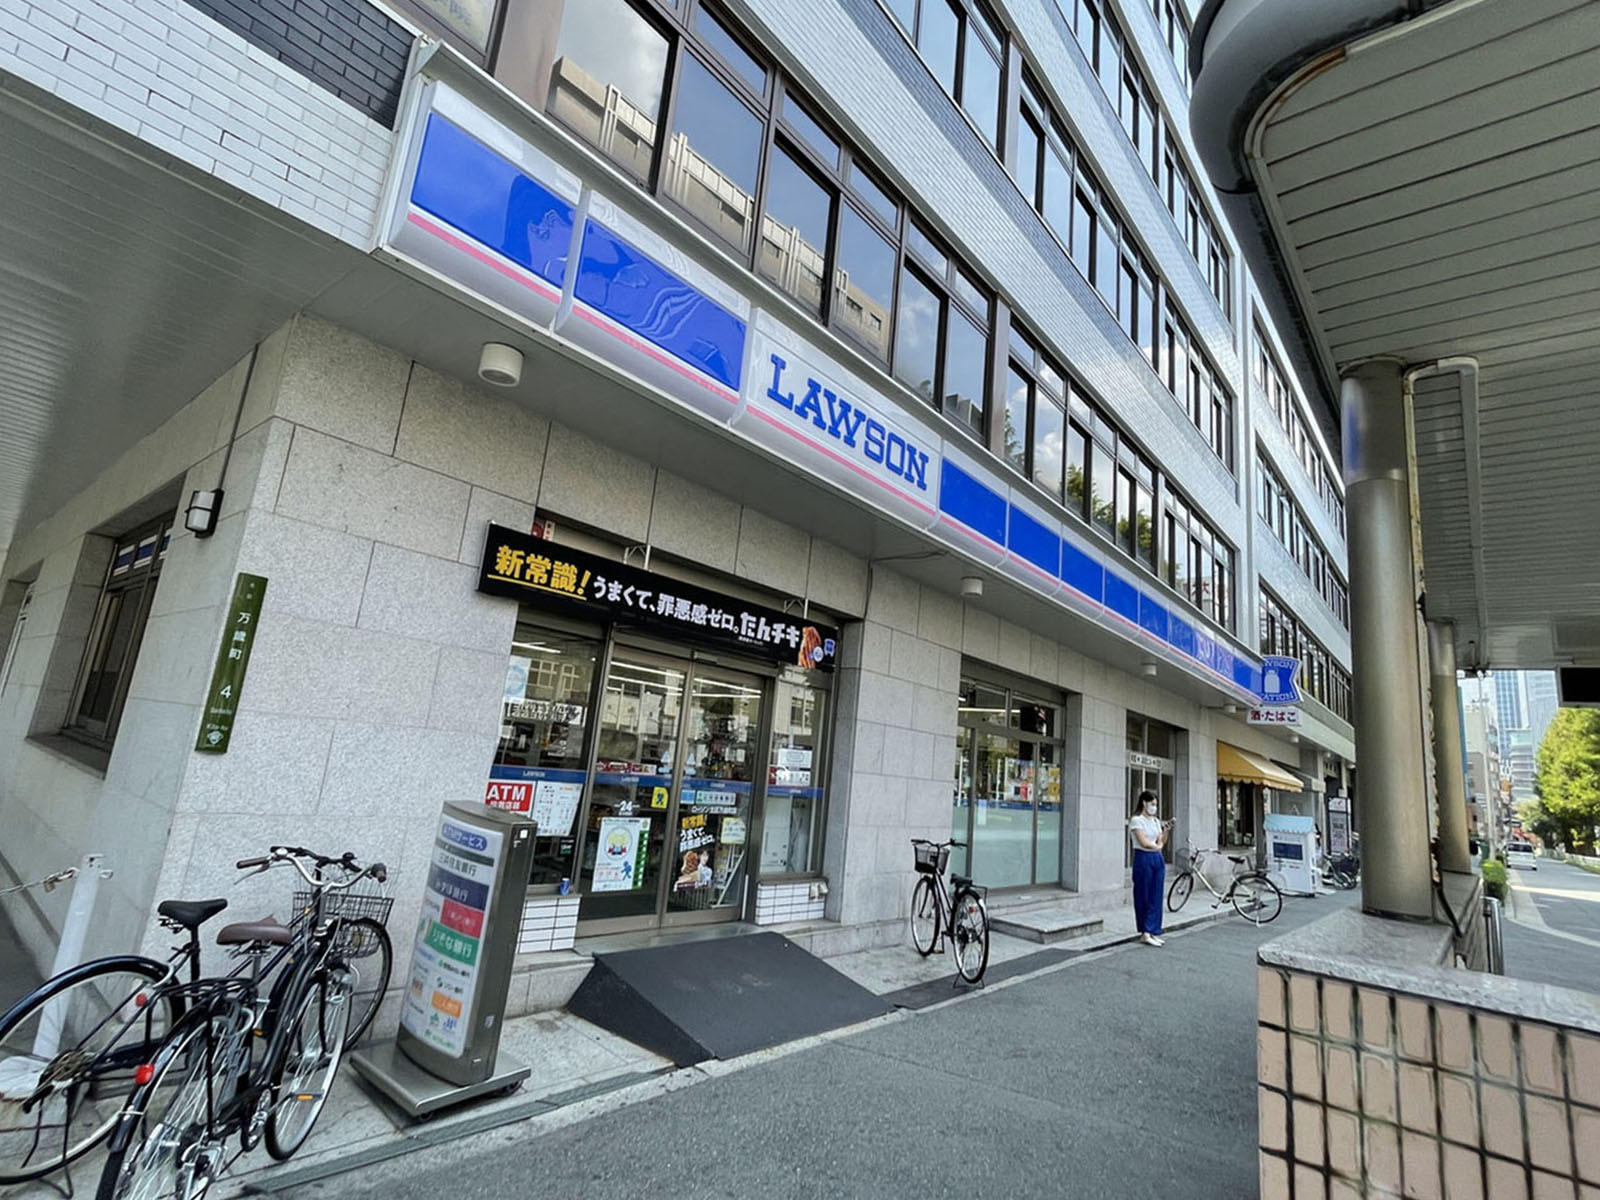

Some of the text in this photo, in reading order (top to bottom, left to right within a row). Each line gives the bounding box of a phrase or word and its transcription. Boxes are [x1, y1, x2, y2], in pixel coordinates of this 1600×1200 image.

[766, 353, 929, 491] LAWSON
[495, 544, 592, 595] 新常識!
[593, 575, 739, 634] うまくて、罪悪感ゼロ。
[220, 685, 232, 699] 4
[487, 785, 526, 801] ATM
